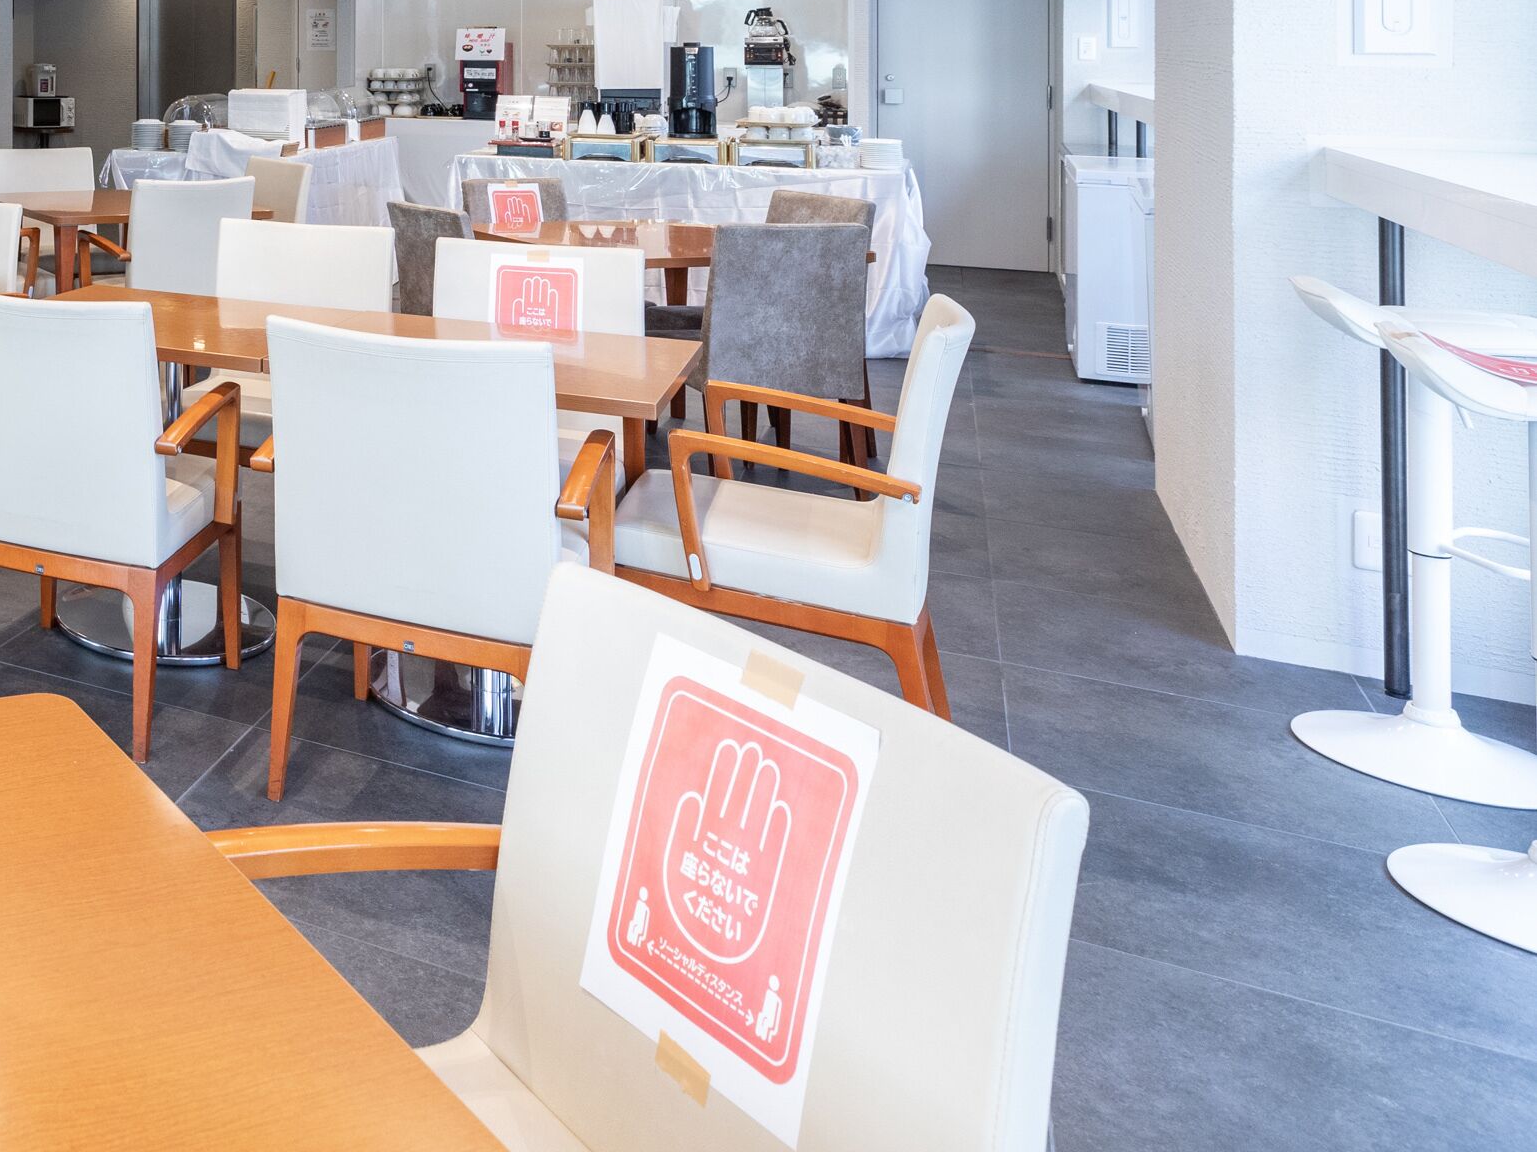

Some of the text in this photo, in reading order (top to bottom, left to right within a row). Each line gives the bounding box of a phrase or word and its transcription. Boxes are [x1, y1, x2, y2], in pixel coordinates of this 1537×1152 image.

[526, 307, 545, 316] ここは
[703, 831, 750, 876] ここは
[680, 851, 759, 918] 座らないで
[683, 890, 742, 941] ください
[658, 936, 743, 1007] ソーシャルディスタンス
